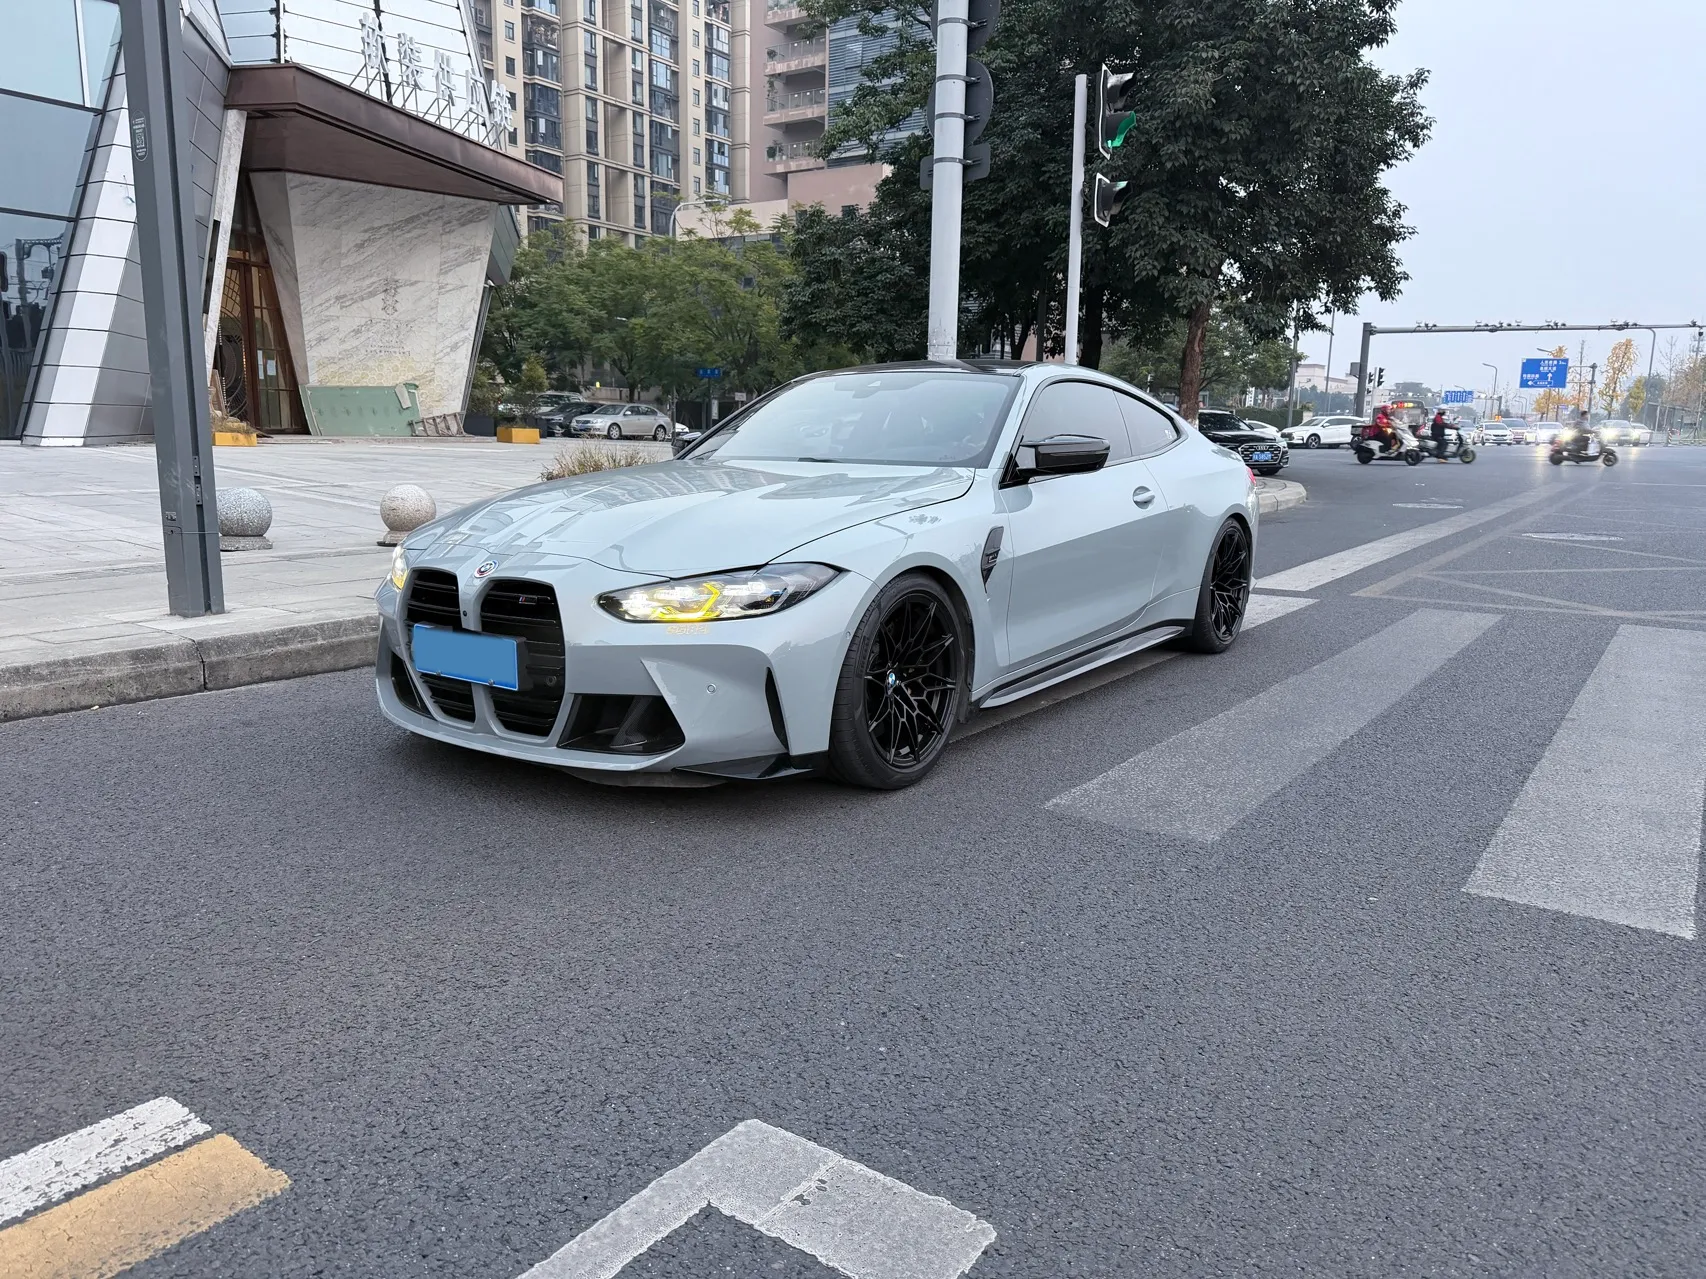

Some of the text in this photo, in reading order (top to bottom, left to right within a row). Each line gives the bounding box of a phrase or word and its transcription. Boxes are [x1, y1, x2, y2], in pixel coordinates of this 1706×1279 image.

[358, 12, 514, 131] 软装供应链
